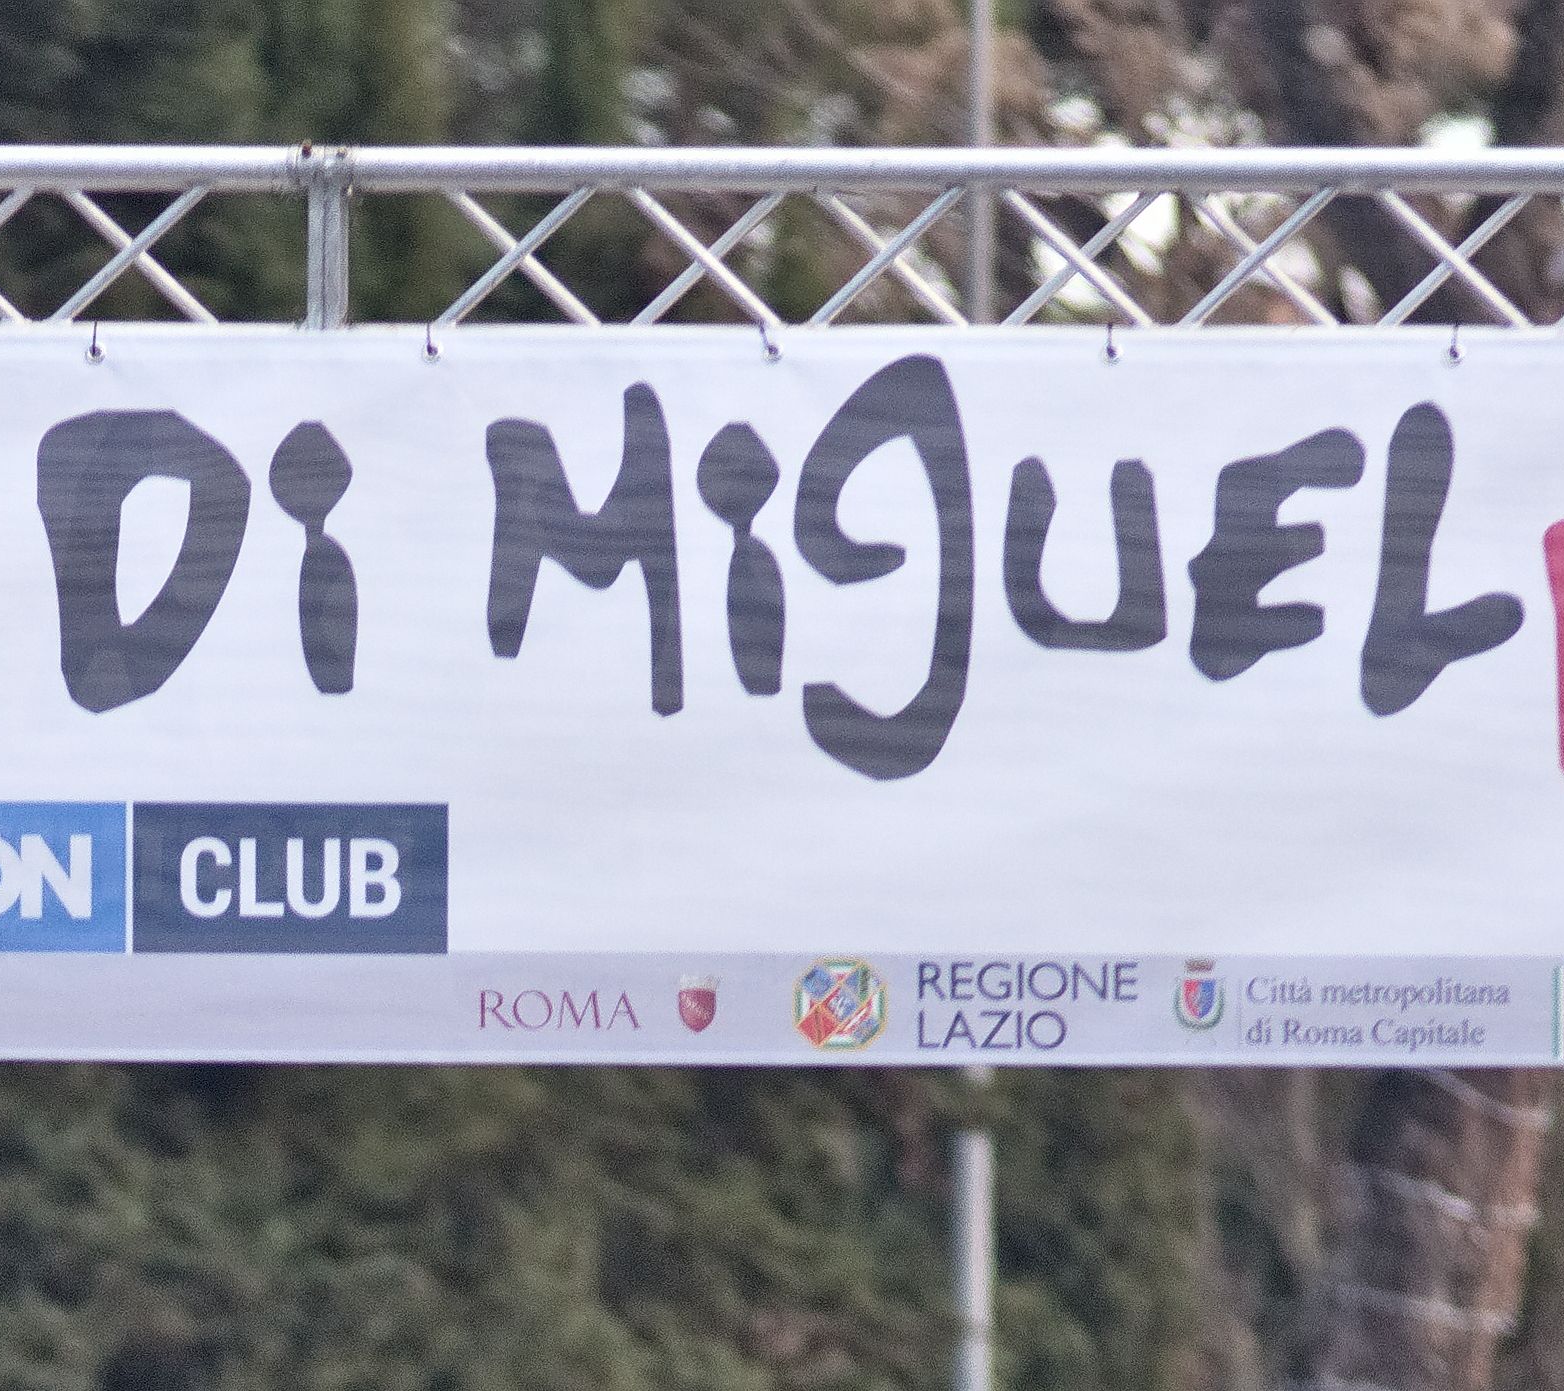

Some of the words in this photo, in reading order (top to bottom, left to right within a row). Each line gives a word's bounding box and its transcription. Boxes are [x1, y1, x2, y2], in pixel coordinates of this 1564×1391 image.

[179, 836, 403, 920] CLUB
[917, 961, 1140, 1002] REGIONE
[1246, 975, 1312, 1003] Città
[1322, 975, 1511, 1012] metropolitana
[477, 987, 641, 1031] ROMA
[917, 1010, 1068, 1050] LAZIO
[1246, 1016, 1272, 1046] di
[1282, 1018, 1363, 1046] Roma
[1372, 1017, 1487, 1051] Capitale
